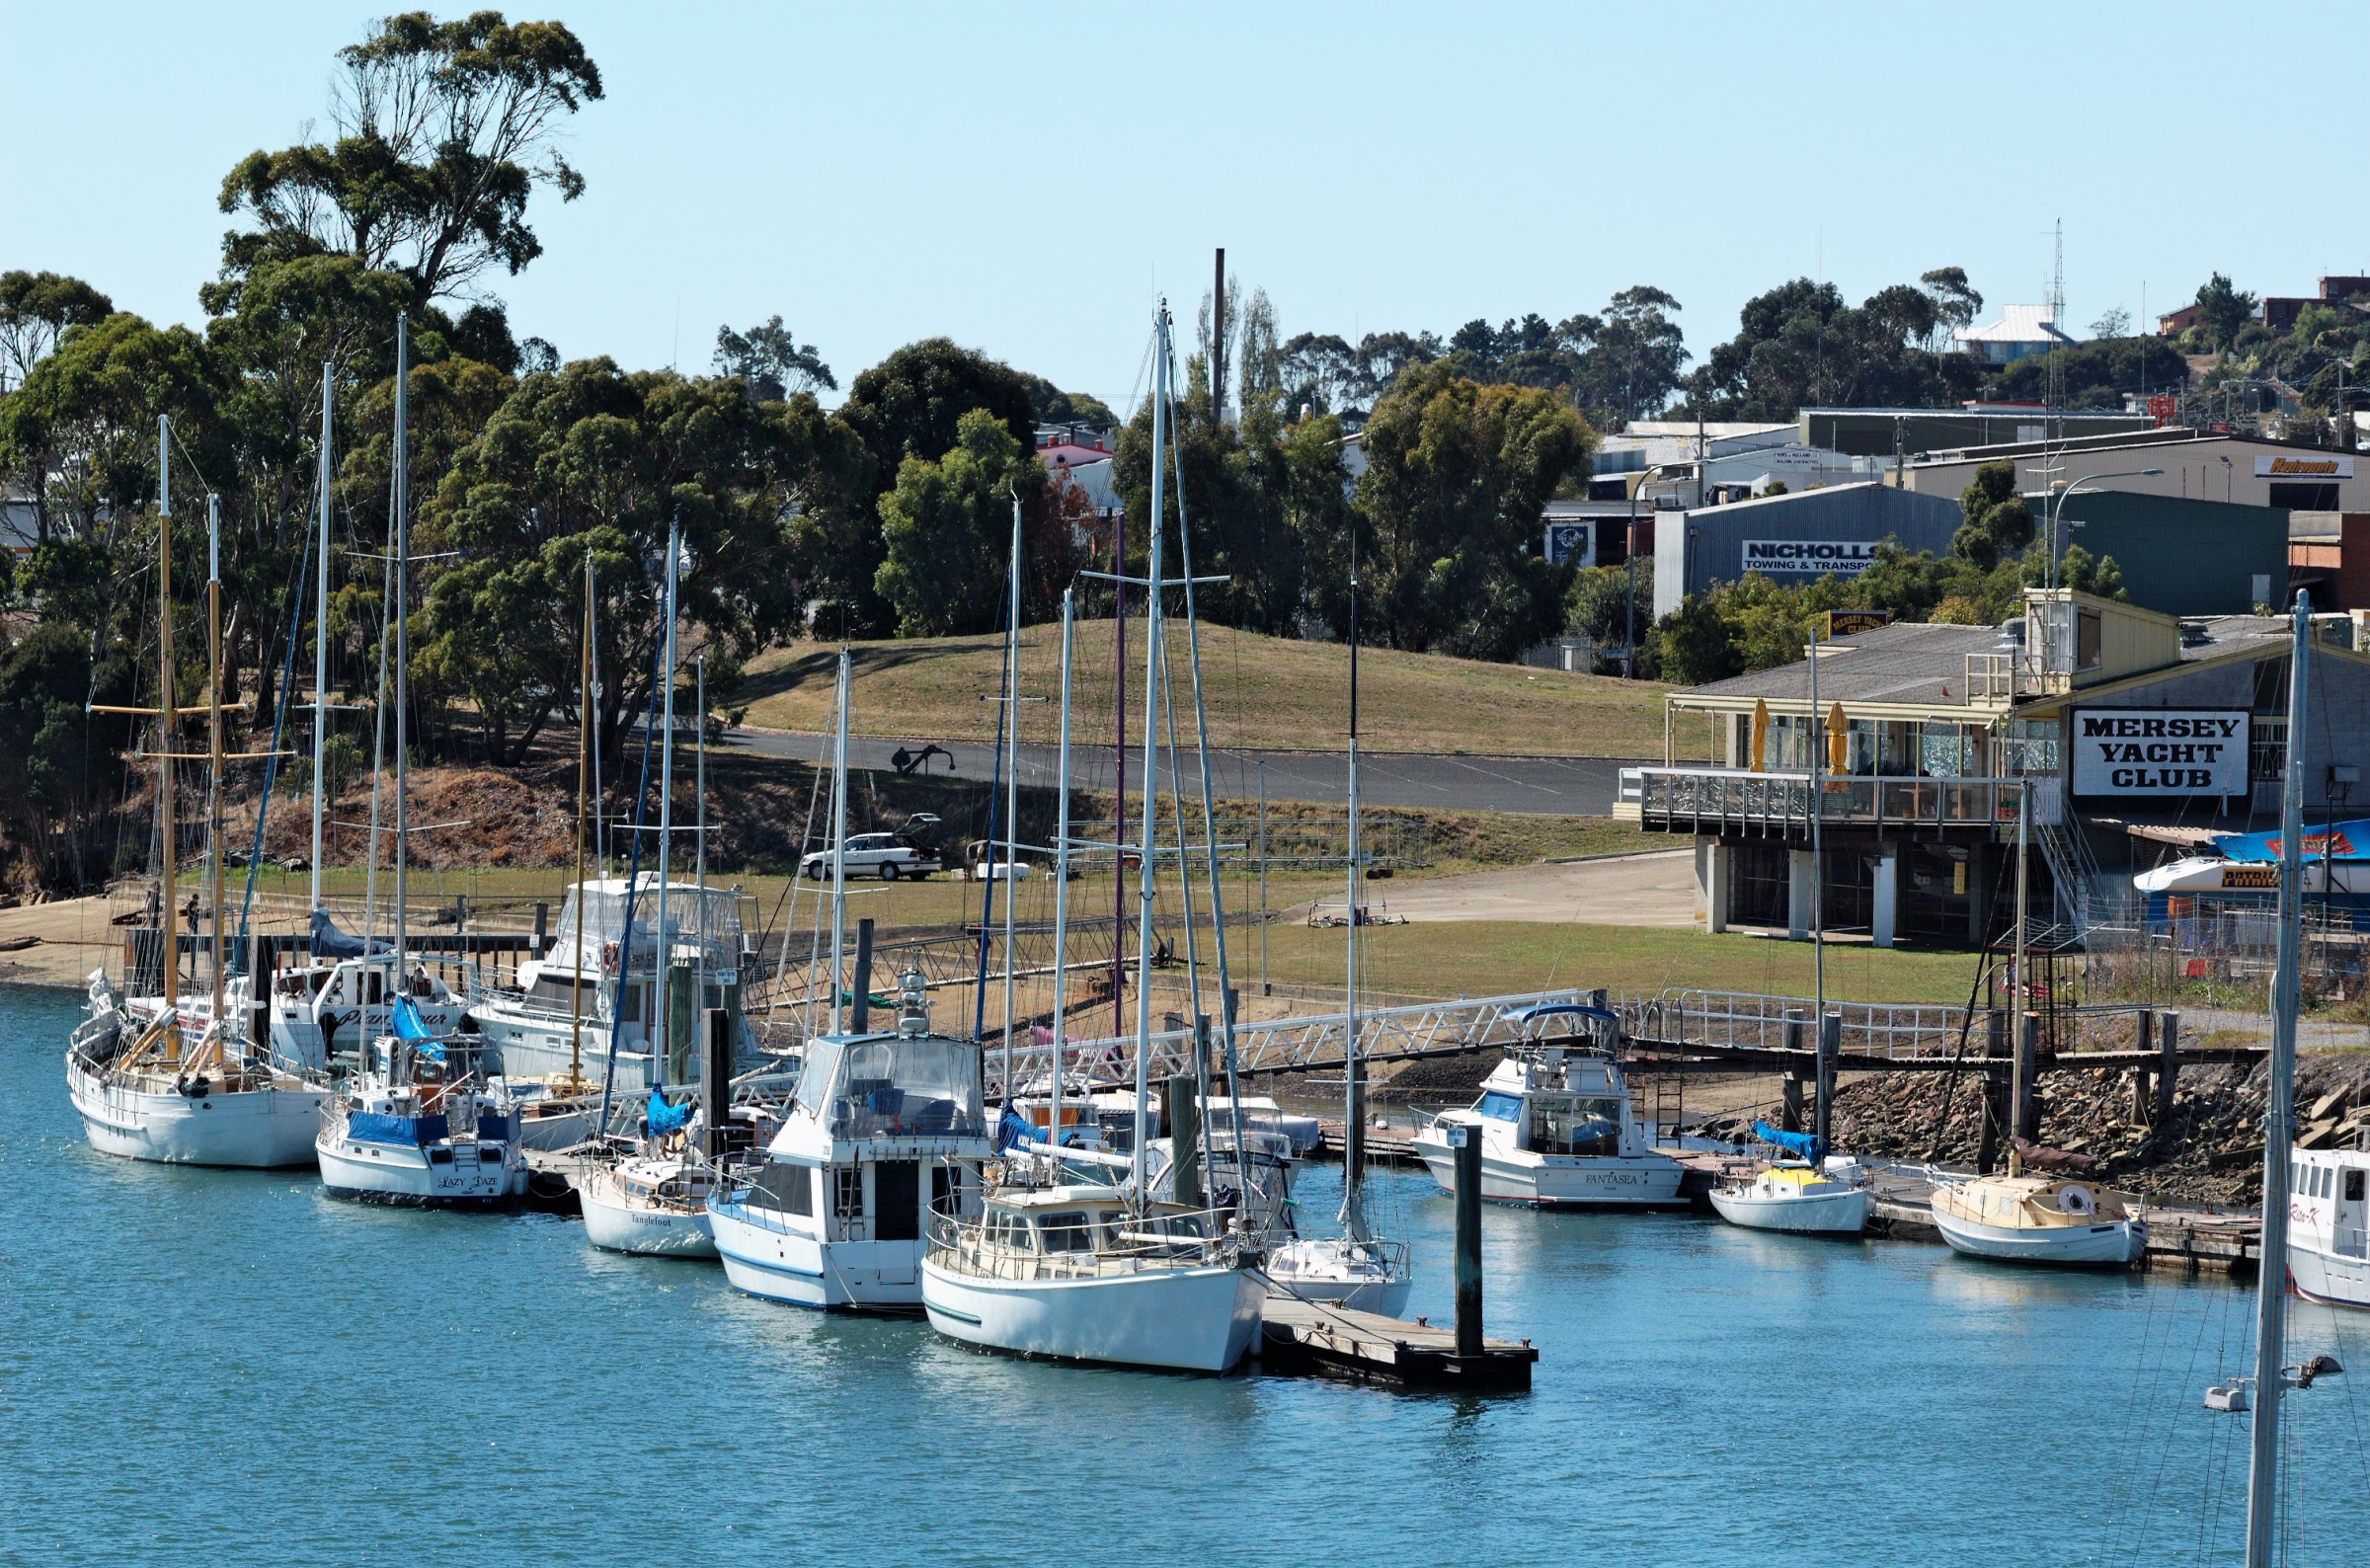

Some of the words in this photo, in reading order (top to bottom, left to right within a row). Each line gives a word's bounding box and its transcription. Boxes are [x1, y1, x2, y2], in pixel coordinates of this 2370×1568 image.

[1745, 560, 1796, 569] TOWING
[1799, 561, 1809, 570] &
[1833, 614, 1862, 631] MERSEY
[1863, 615, 1885, 628] YACH
[2083, 717, 2241, 739] MERSEY
[2097, 743, 2224, 763] YACHT
[2111, 768, 2212, 788] CLUB
[437, 1175, 466, 1189] LAZY
[472, 1175, 499, 1188] DAZE
[1586, 1174, 1637, 1185] FANTASEA
[631, 1214, 672, 1227] Tanglefoot
